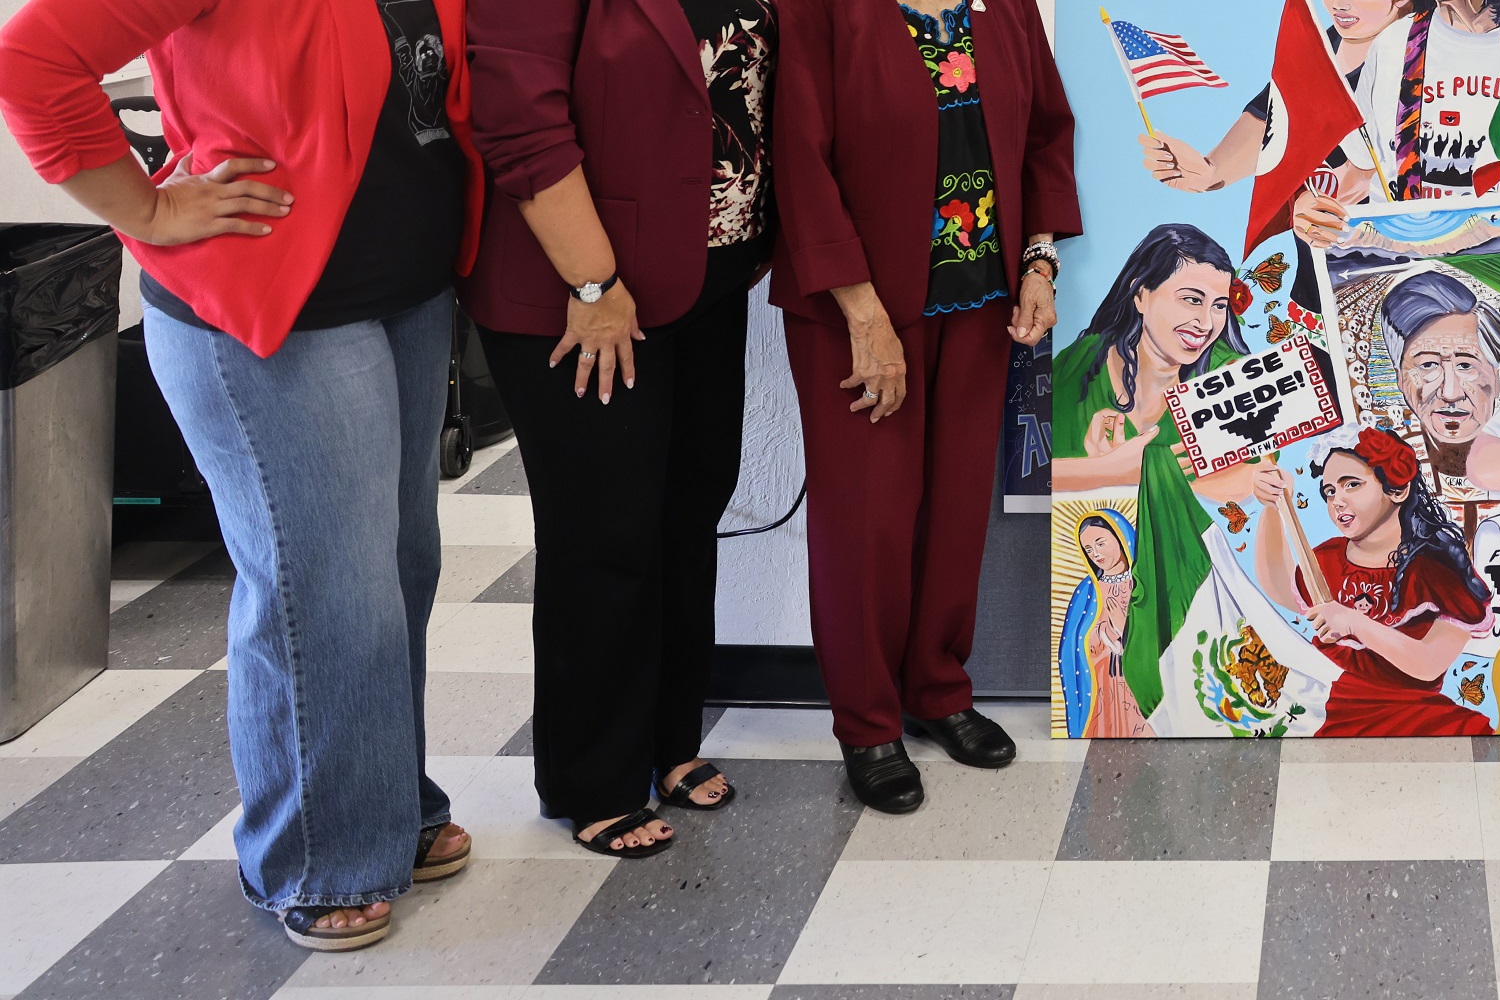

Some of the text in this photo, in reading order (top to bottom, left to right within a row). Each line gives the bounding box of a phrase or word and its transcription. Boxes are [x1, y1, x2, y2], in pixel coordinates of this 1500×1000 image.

[1423, 80, 1445, 104] SE
[1241, 351, 1284, 380] SE
[1191, 370, 1306, 430] PUEDE!
